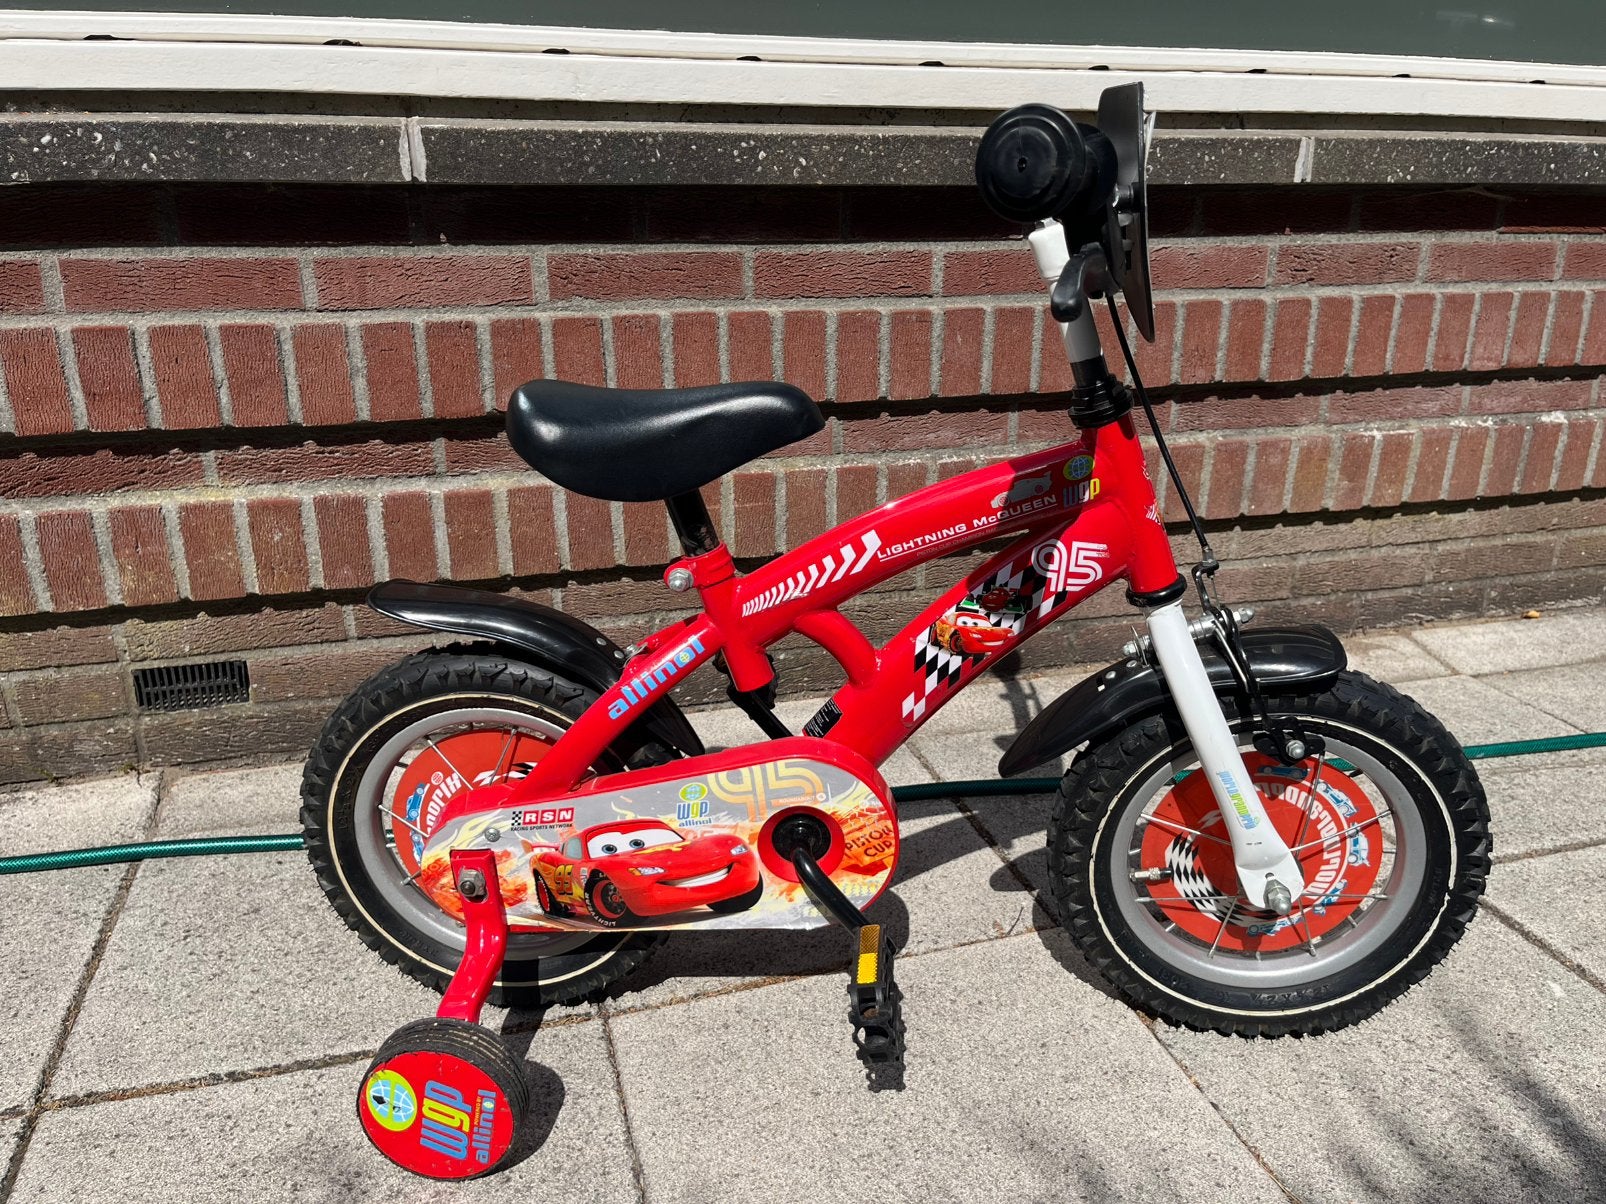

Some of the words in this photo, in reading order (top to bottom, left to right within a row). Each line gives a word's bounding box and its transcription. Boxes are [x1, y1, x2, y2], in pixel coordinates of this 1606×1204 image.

[877, 523, 967, 560] LIGHTNING
[973, 494, 1057, 529] McQUEEN
[1031, 539, 1107, 592] 95
[607, 635, 705, 720] allinol
[524, 809, 574, 823] RSN
[677, 801, 709, 820] wgp
[706, 758, 824, 823] 95
[678, 818, 712, 828] allinol
[864, 840, 893, 857] CUP
[554, 864, 574, 895] 95
[420, 1080, 472, 1160] wgp
[472, 1089, 497, 1164] allinol
